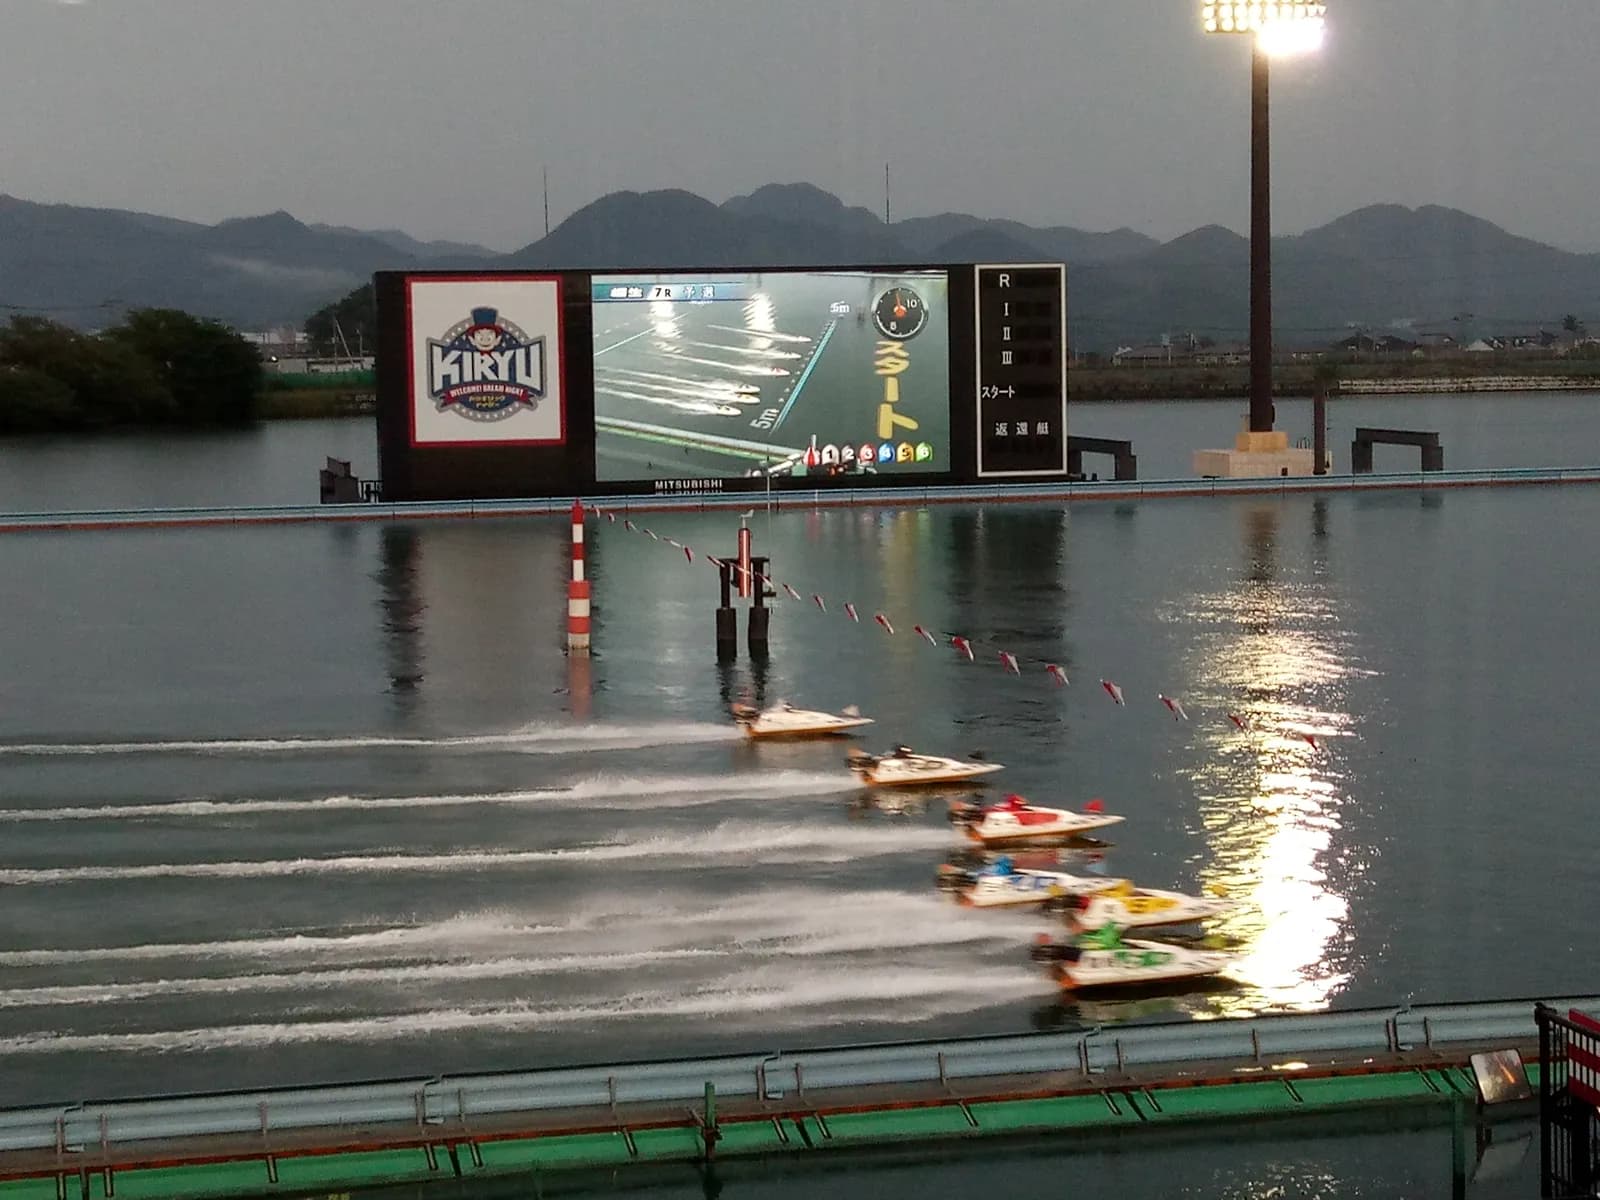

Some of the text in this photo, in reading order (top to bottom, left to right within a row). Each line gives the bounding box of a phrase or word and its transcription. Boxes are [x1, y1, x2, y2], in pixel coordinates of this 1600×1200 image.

[1000, 274, 1010, 288] R
[432, 343, 542, 392] KIRYU
[982, 385, 1016, 399] スタート
